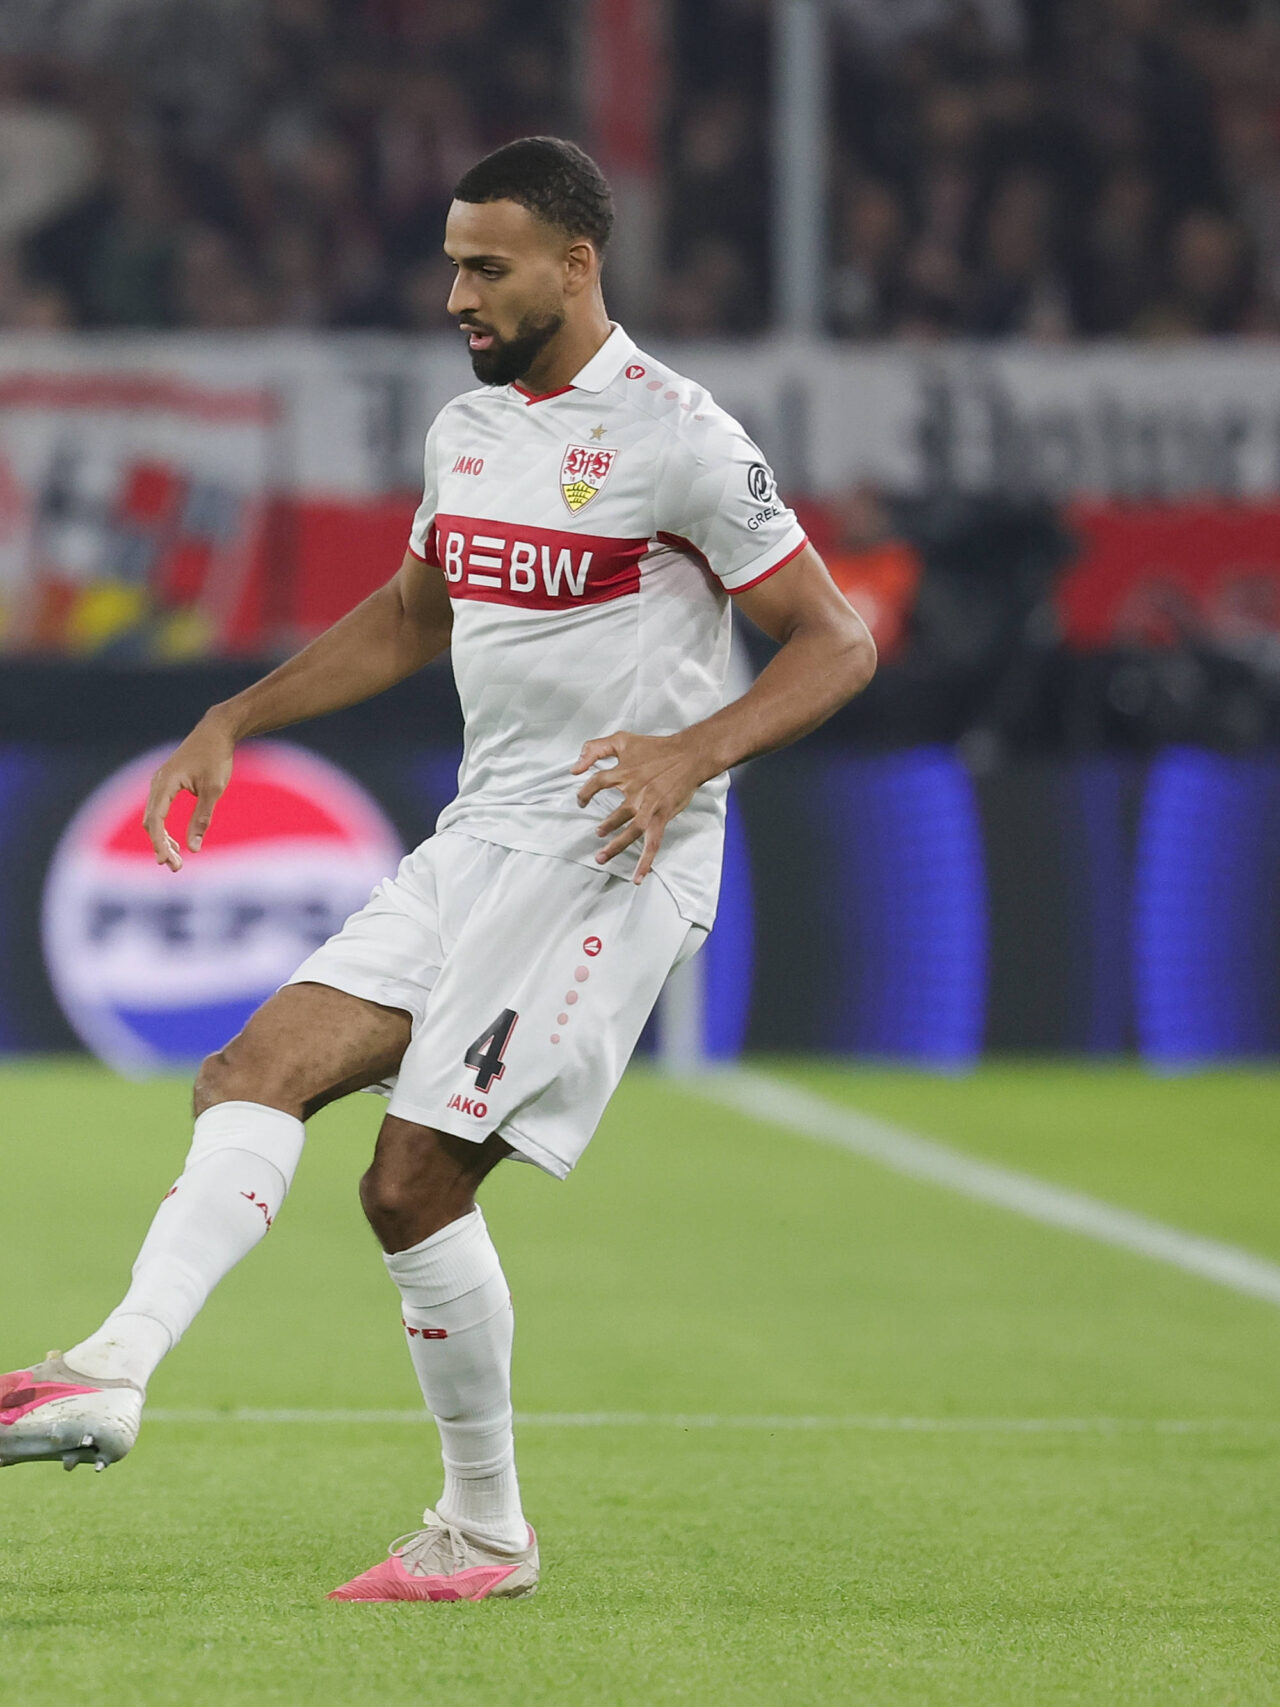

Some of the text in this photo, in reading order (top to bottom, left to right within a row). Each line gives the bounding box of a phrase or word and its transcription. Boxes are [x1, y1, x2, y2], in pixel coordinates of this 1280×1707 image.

[451, 455, 485, 476] JAKO
[464, 1007, 519, 1094] 4
[446, 1093, 488, 1118] JAKO
